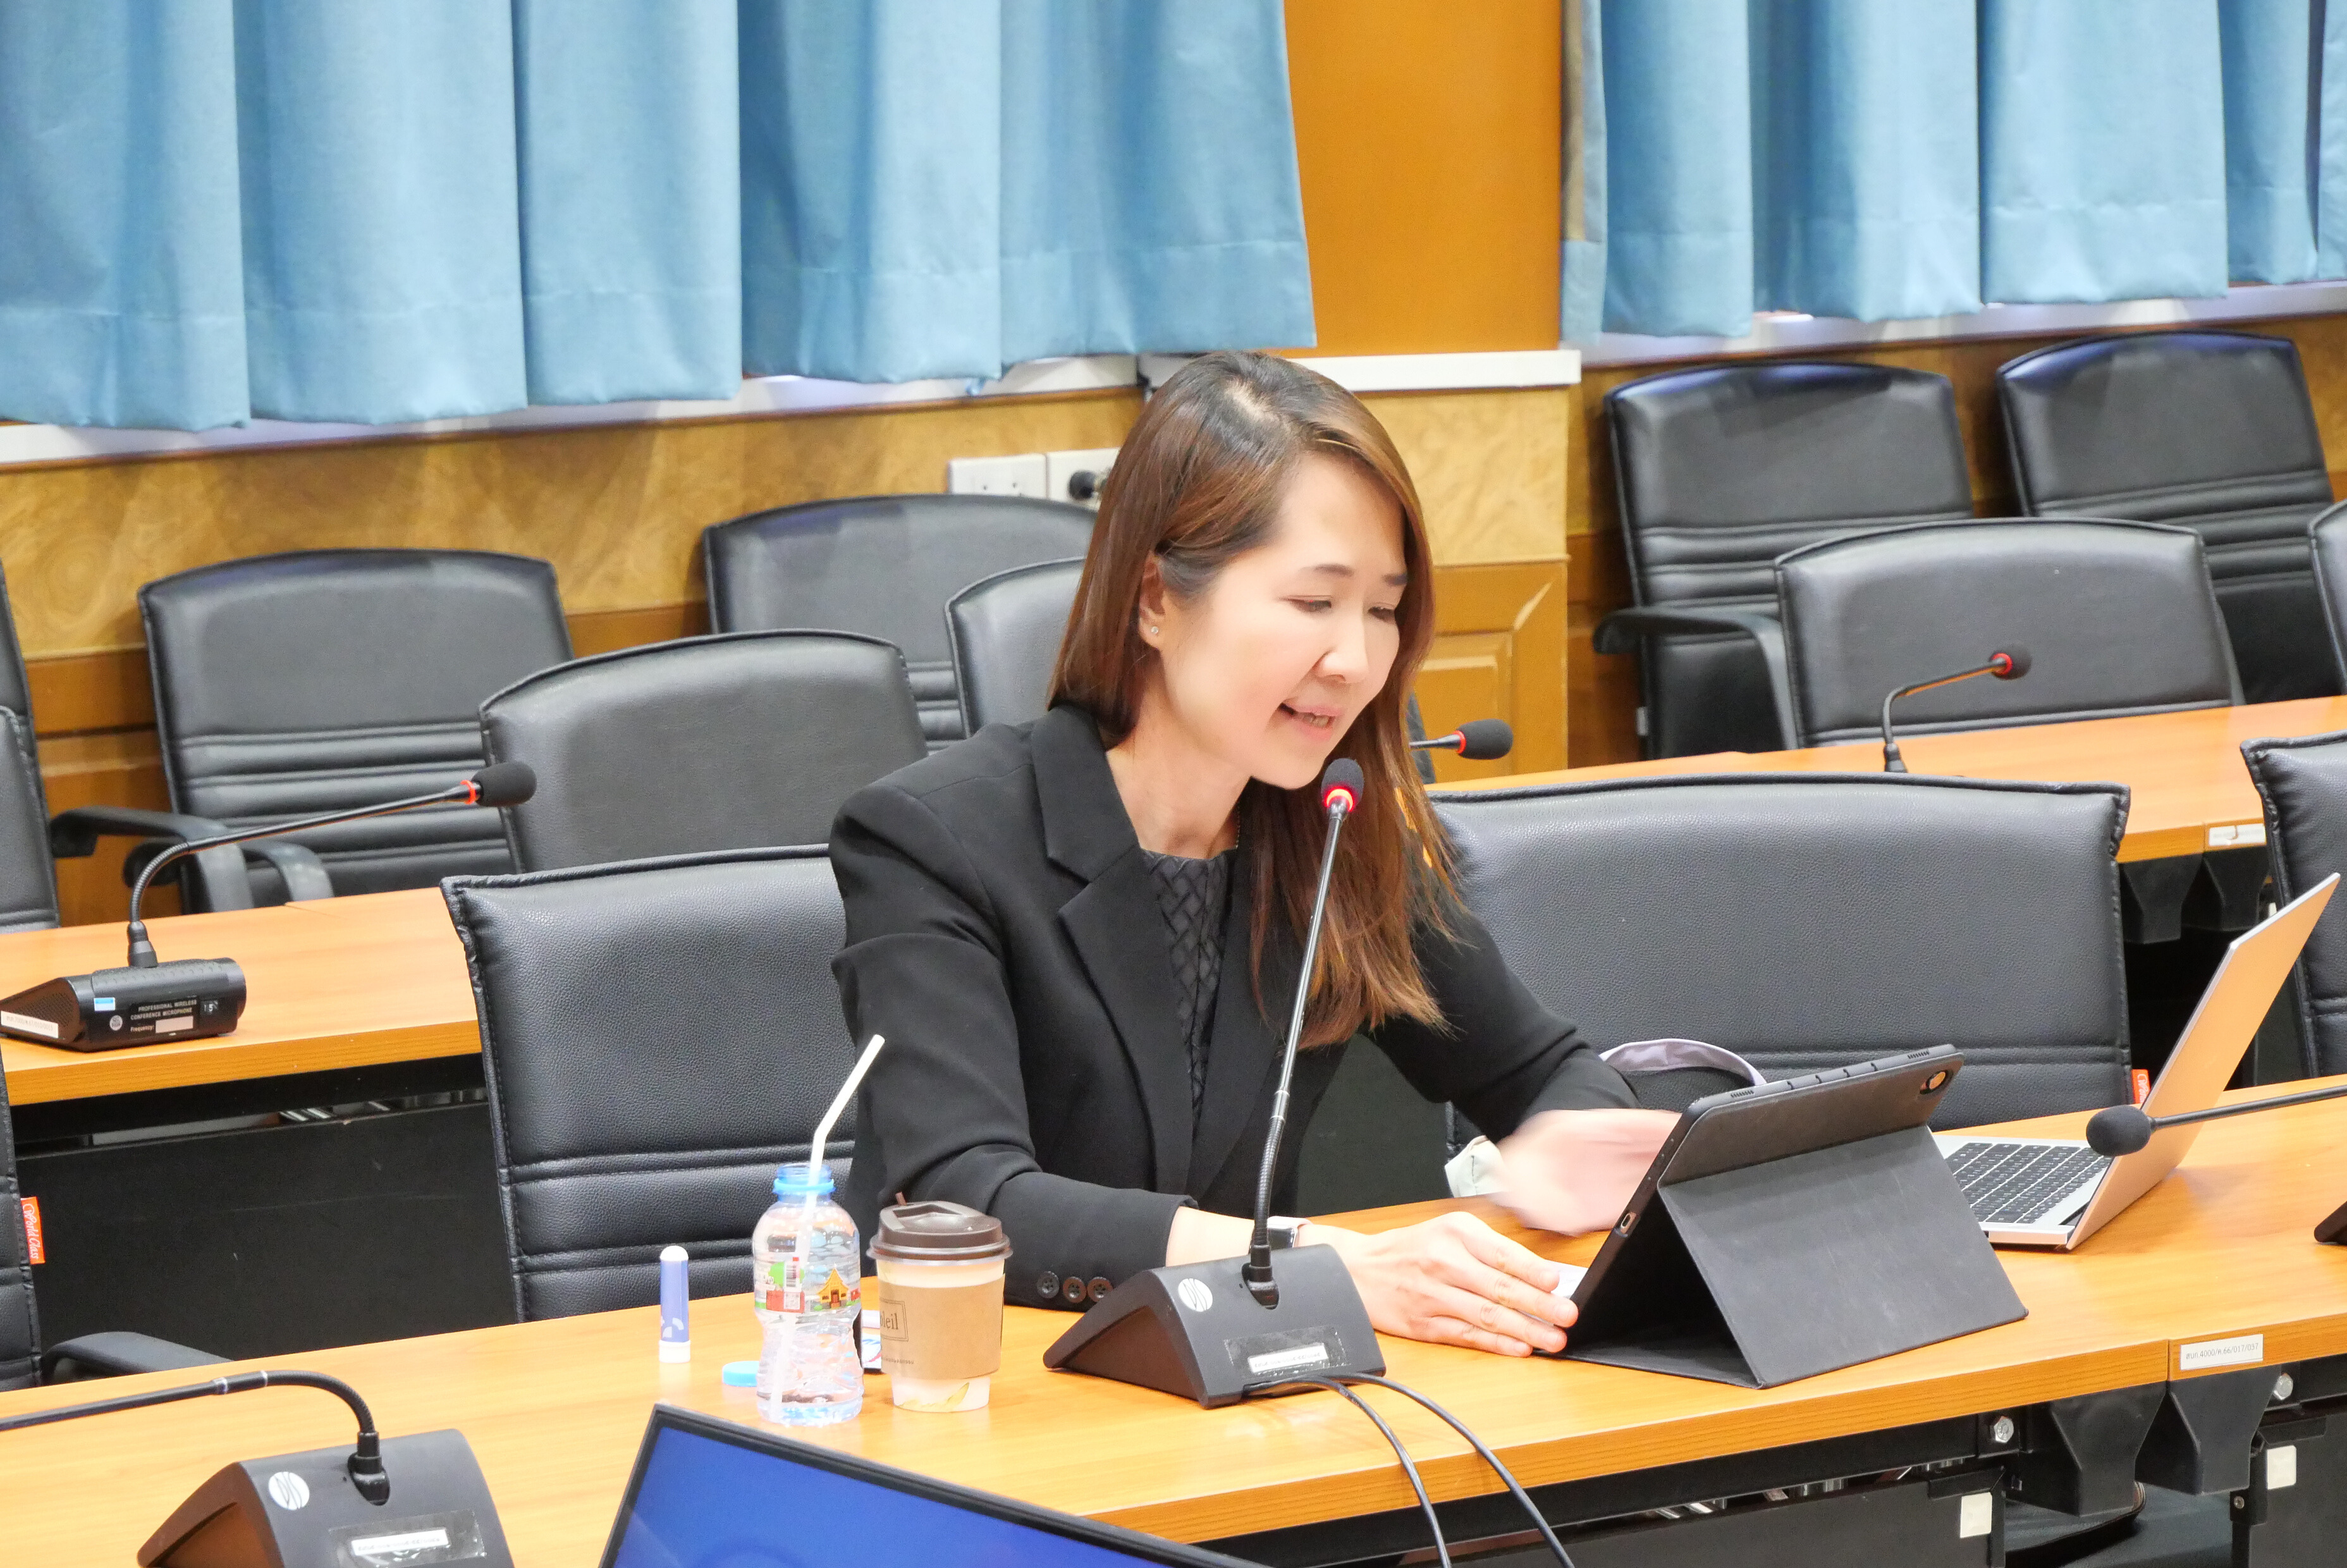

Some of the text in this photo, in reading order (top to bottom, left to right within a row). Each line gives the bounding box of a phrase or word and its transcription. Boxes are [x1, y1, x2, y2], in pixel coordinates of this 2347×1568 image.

[138, 999, 197, 1012] PROFESSIONAL WIRELESS
[130, 1007, 192, 1020] CONFERENCE MICROPHONE
[23, 1203, 41, 1259] World Class
